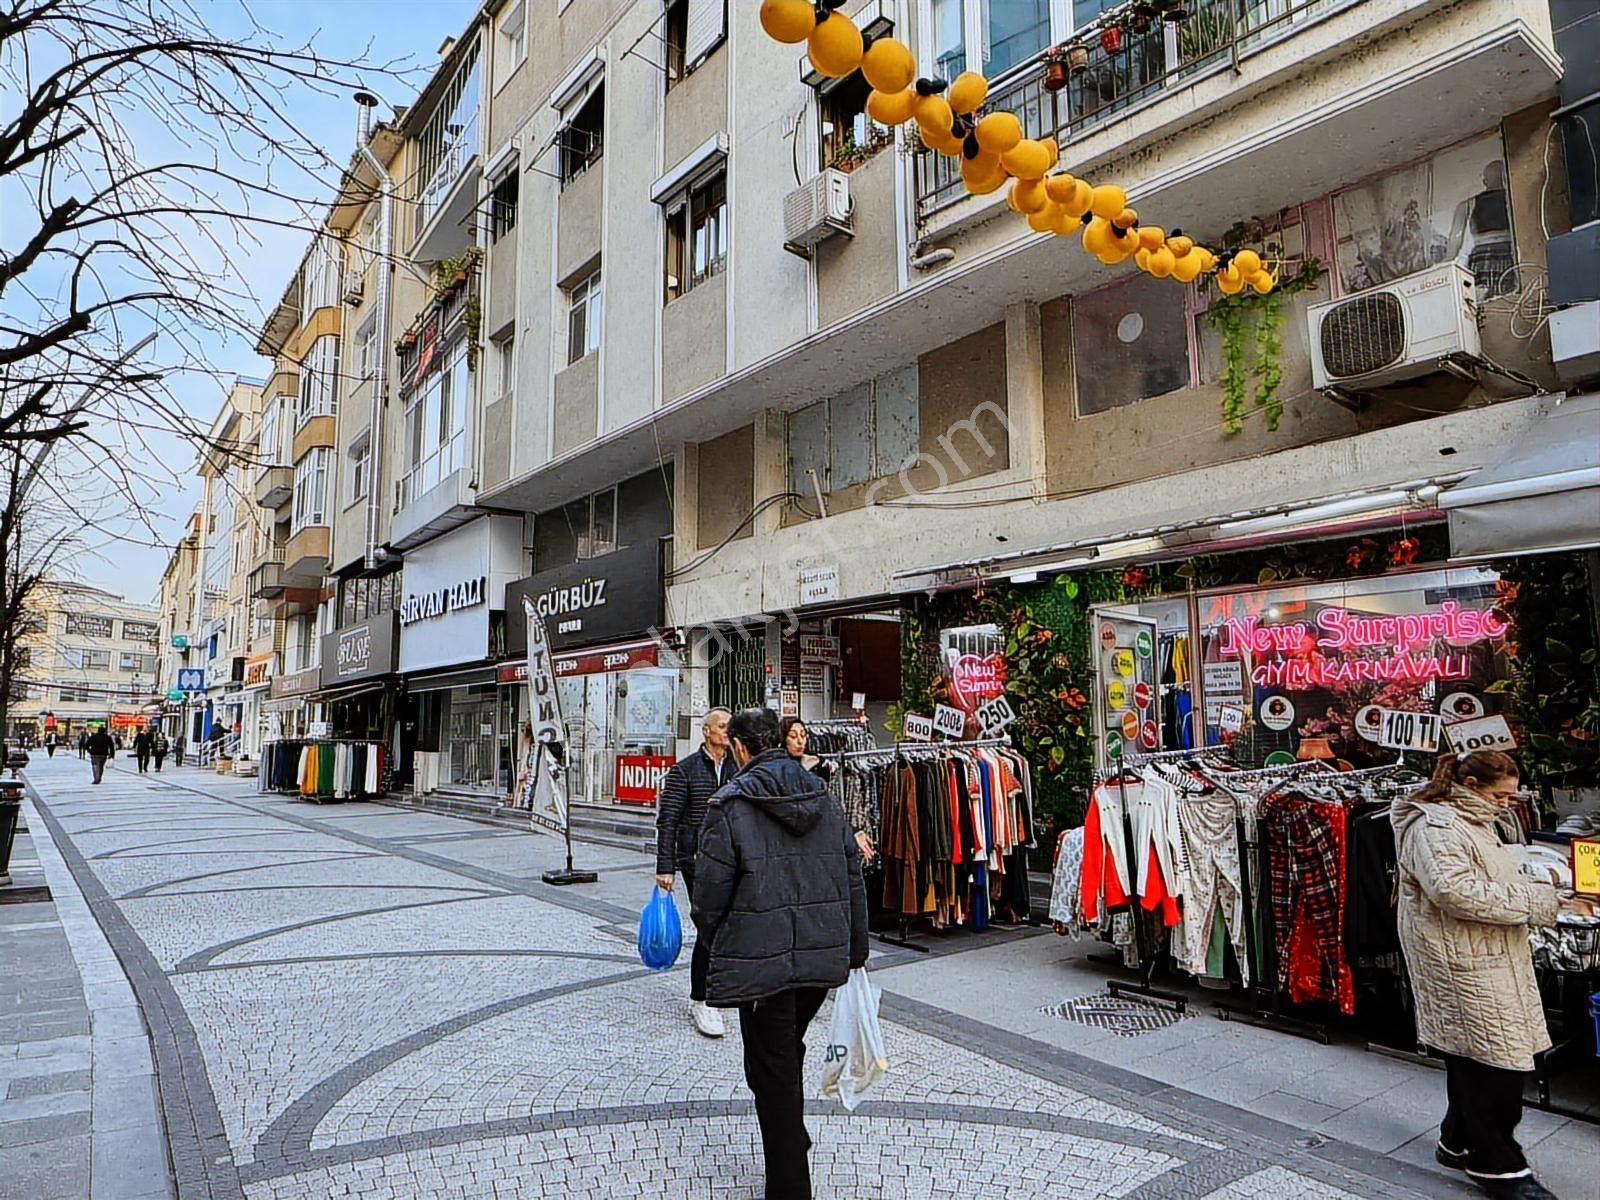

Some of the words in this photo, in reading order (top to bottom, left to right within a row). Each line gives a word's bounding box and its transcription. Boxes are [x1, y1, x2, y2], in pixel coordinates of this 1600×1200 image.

[537, 577, 606, 619] GÜRBÜZ
[1221, 614, 1305, 653] New
[964, 662, 995, 678] New
[1320, 653, 1466, 683] KARNAVALI
[907, 721, 930, 736] 800
[979, 699, 1010, 730] 250
[1386, 713, 1414, 746] 100
[1419, 716, 1438, 749] TL
[619, 758, 671, 790] İNDİRİ
[1578, 844, 1597, 856] ÇOK
